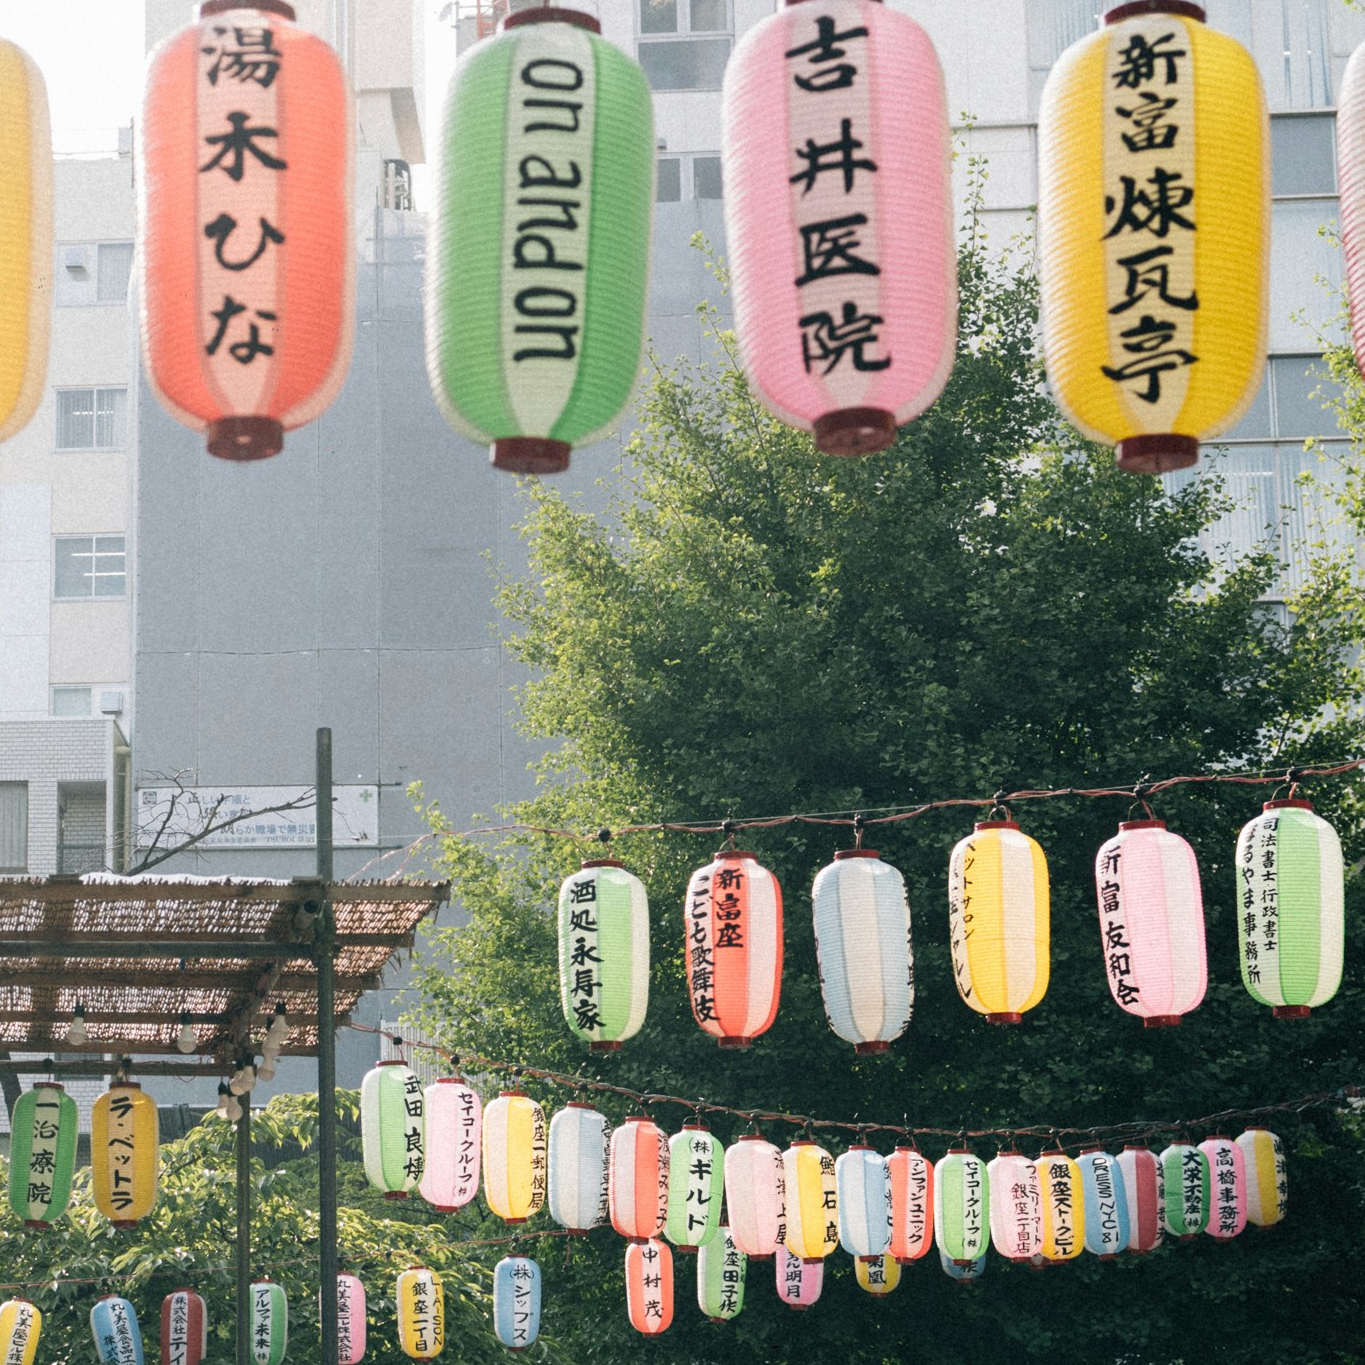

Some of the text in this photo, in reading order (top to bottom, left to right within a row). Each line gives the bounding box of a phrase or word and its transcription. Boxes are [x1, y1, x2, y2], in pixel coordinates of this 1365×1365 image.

[521, 58, 584, 134] on
[198, 27, 287, 365] 湯木ひな
[785, 15, 892, 376] 吉井医院
[714, 868, 745, 949] 新富座
[27, 1101, 59, 1205] 一治療院
[108, 1096, 135, 1211] ラ・ベットラ
[527, 1107, 547, 1210] 銀座一郵便局
[686, 1136, 715, 1232] (株)ギルド
[1092, 1157, 1112, 1198] DRESS
[1216, 1147, 1240, 1234] 高橋事務所
[1010, 1182, 1031, 1255] 銀座一丁目店
[1025, 1164, 1042, 1246] ファミリーマート
[1049, 1162, 1073, 1256] 銀座ストークビル
[1099, 1200, 1118, 1230] NYC
[412, 1281, 429, 1352] 銀座一丁目
[509, 1263, 535, 1341] (株)シップス
[642, 1247, 665, 1319] 中村茂
